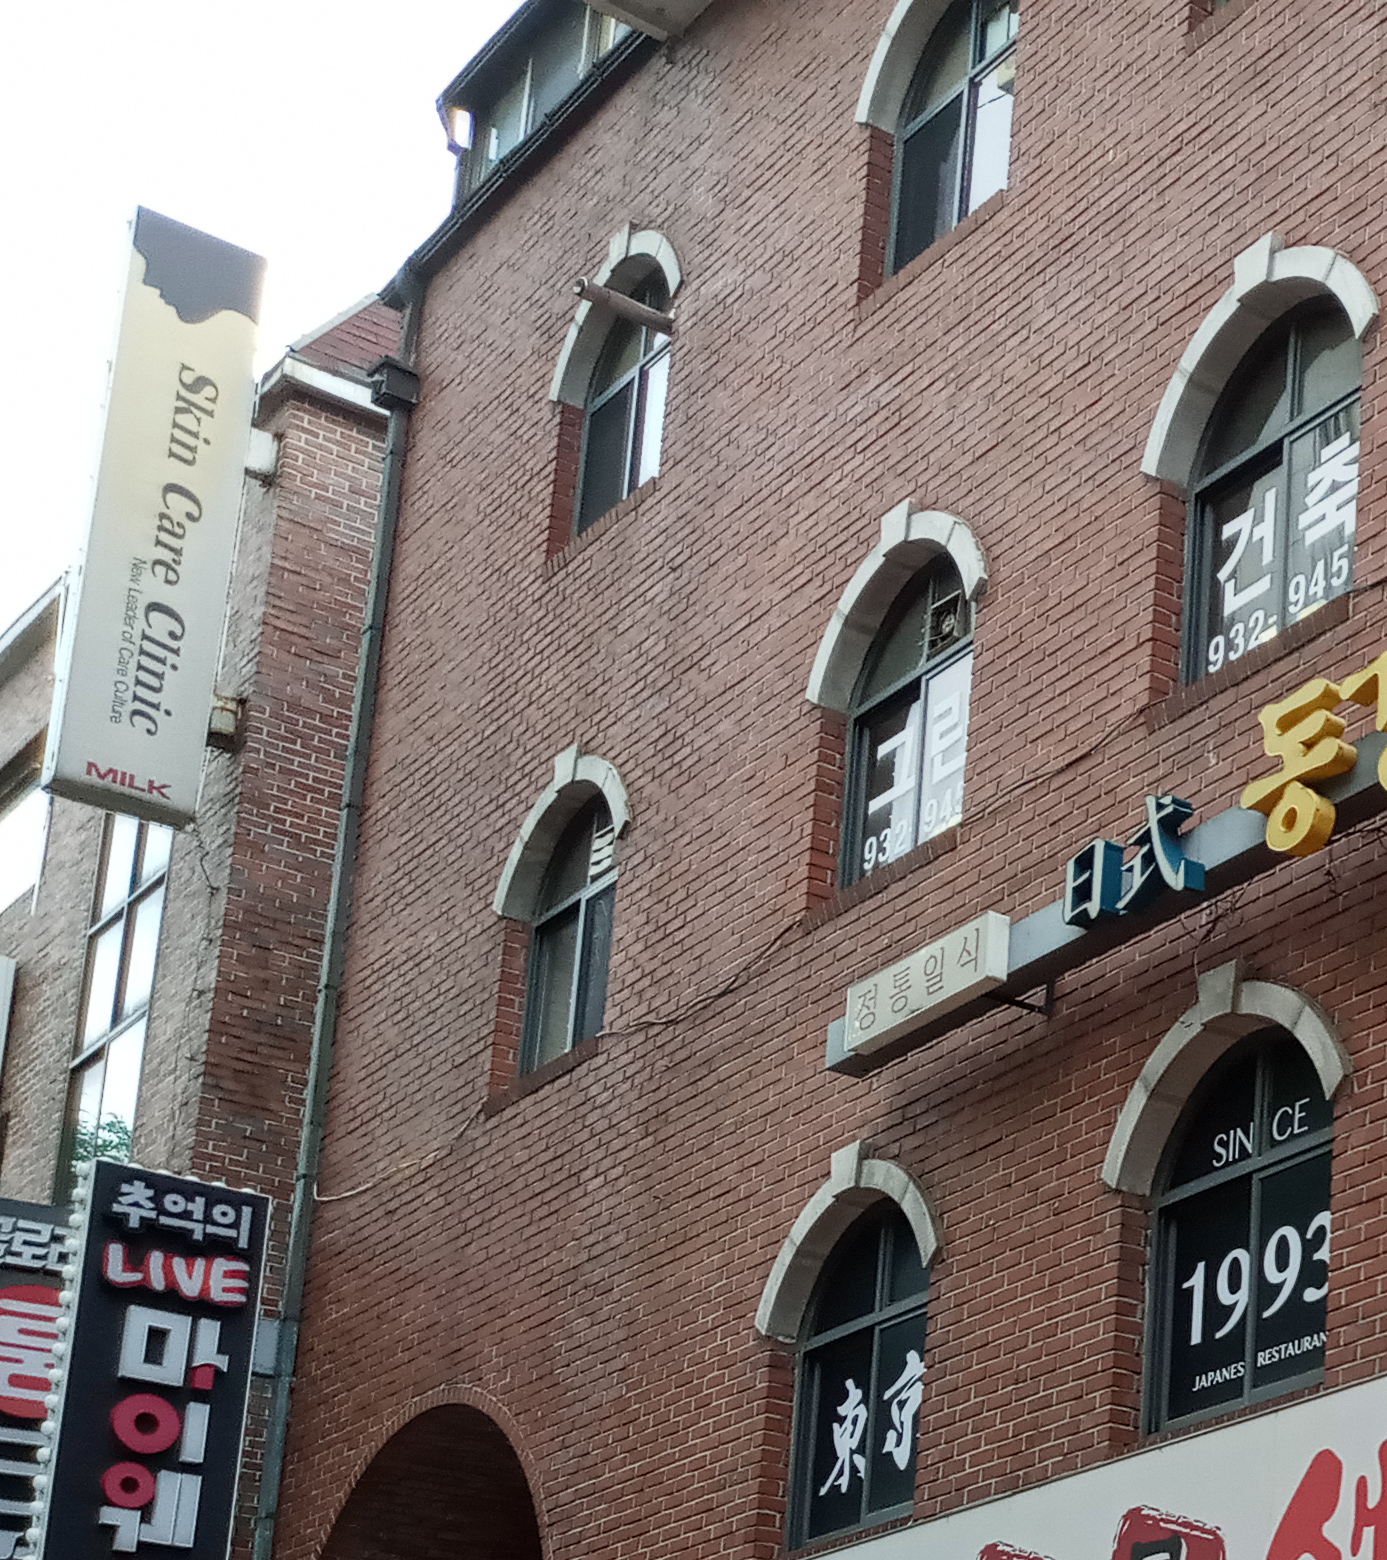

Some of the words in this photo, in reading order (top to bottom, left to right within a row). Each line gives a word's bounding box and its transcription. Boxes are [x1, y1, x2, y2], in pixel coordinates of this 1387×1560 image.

[167, 361, 219, 473] Skin
[152, 481, 203, 588] Care
[1216, 431, 1361, 617] 건축
[129, 601, 186, 738] Clinic
[86, 761, 172, 799] MILK
[1063, 794, 1206, 918] 日式
[855, 928, 980, 1031] 정통일식
[1212, 1097, 1310, 1168] SINCE
[111, 1180, 252, 1249] 추억의
[103, 1240, 251, 1307] LIVE
[1182, 1210, 1331, 1346] 1993
[1192, 1361, 1245, 1392] JAPANES
[1256, 1331, 1327, 1367] RESTAURAN
